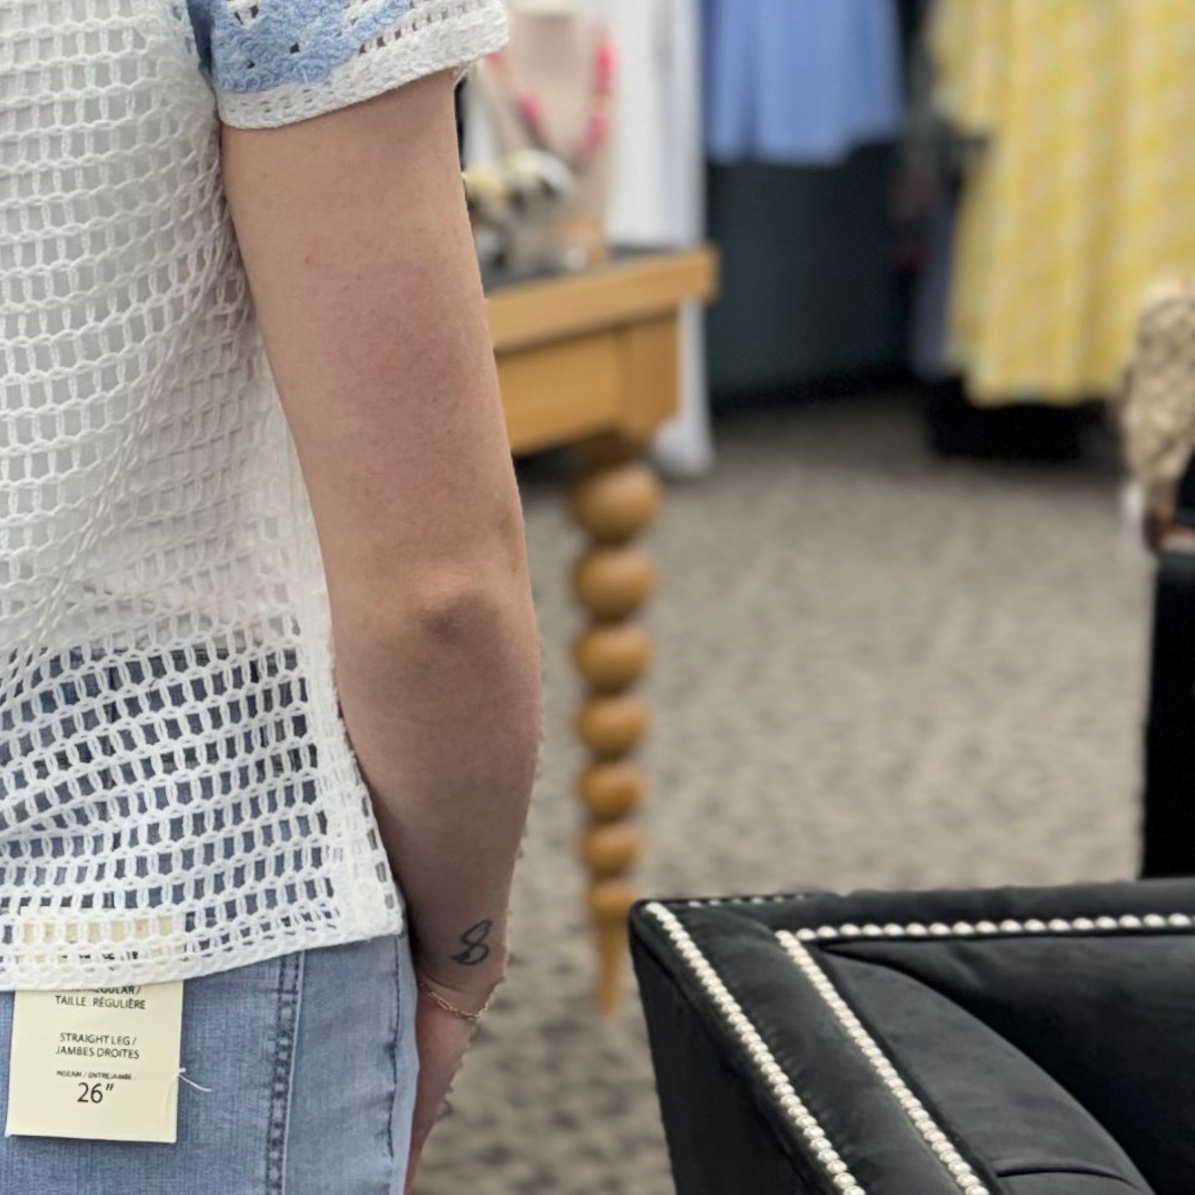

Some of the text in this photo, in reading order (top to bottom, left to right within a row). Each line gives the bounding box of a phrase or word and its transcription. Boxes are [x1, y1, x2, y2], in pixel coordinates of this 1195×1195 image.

[55, 995, 146, 1009] TAILLE RÉGULIÈRE
[60, 1032, 110, 1044] STRAIGHT
[56, 1045, 140, 1059] JAMBES DROITES
